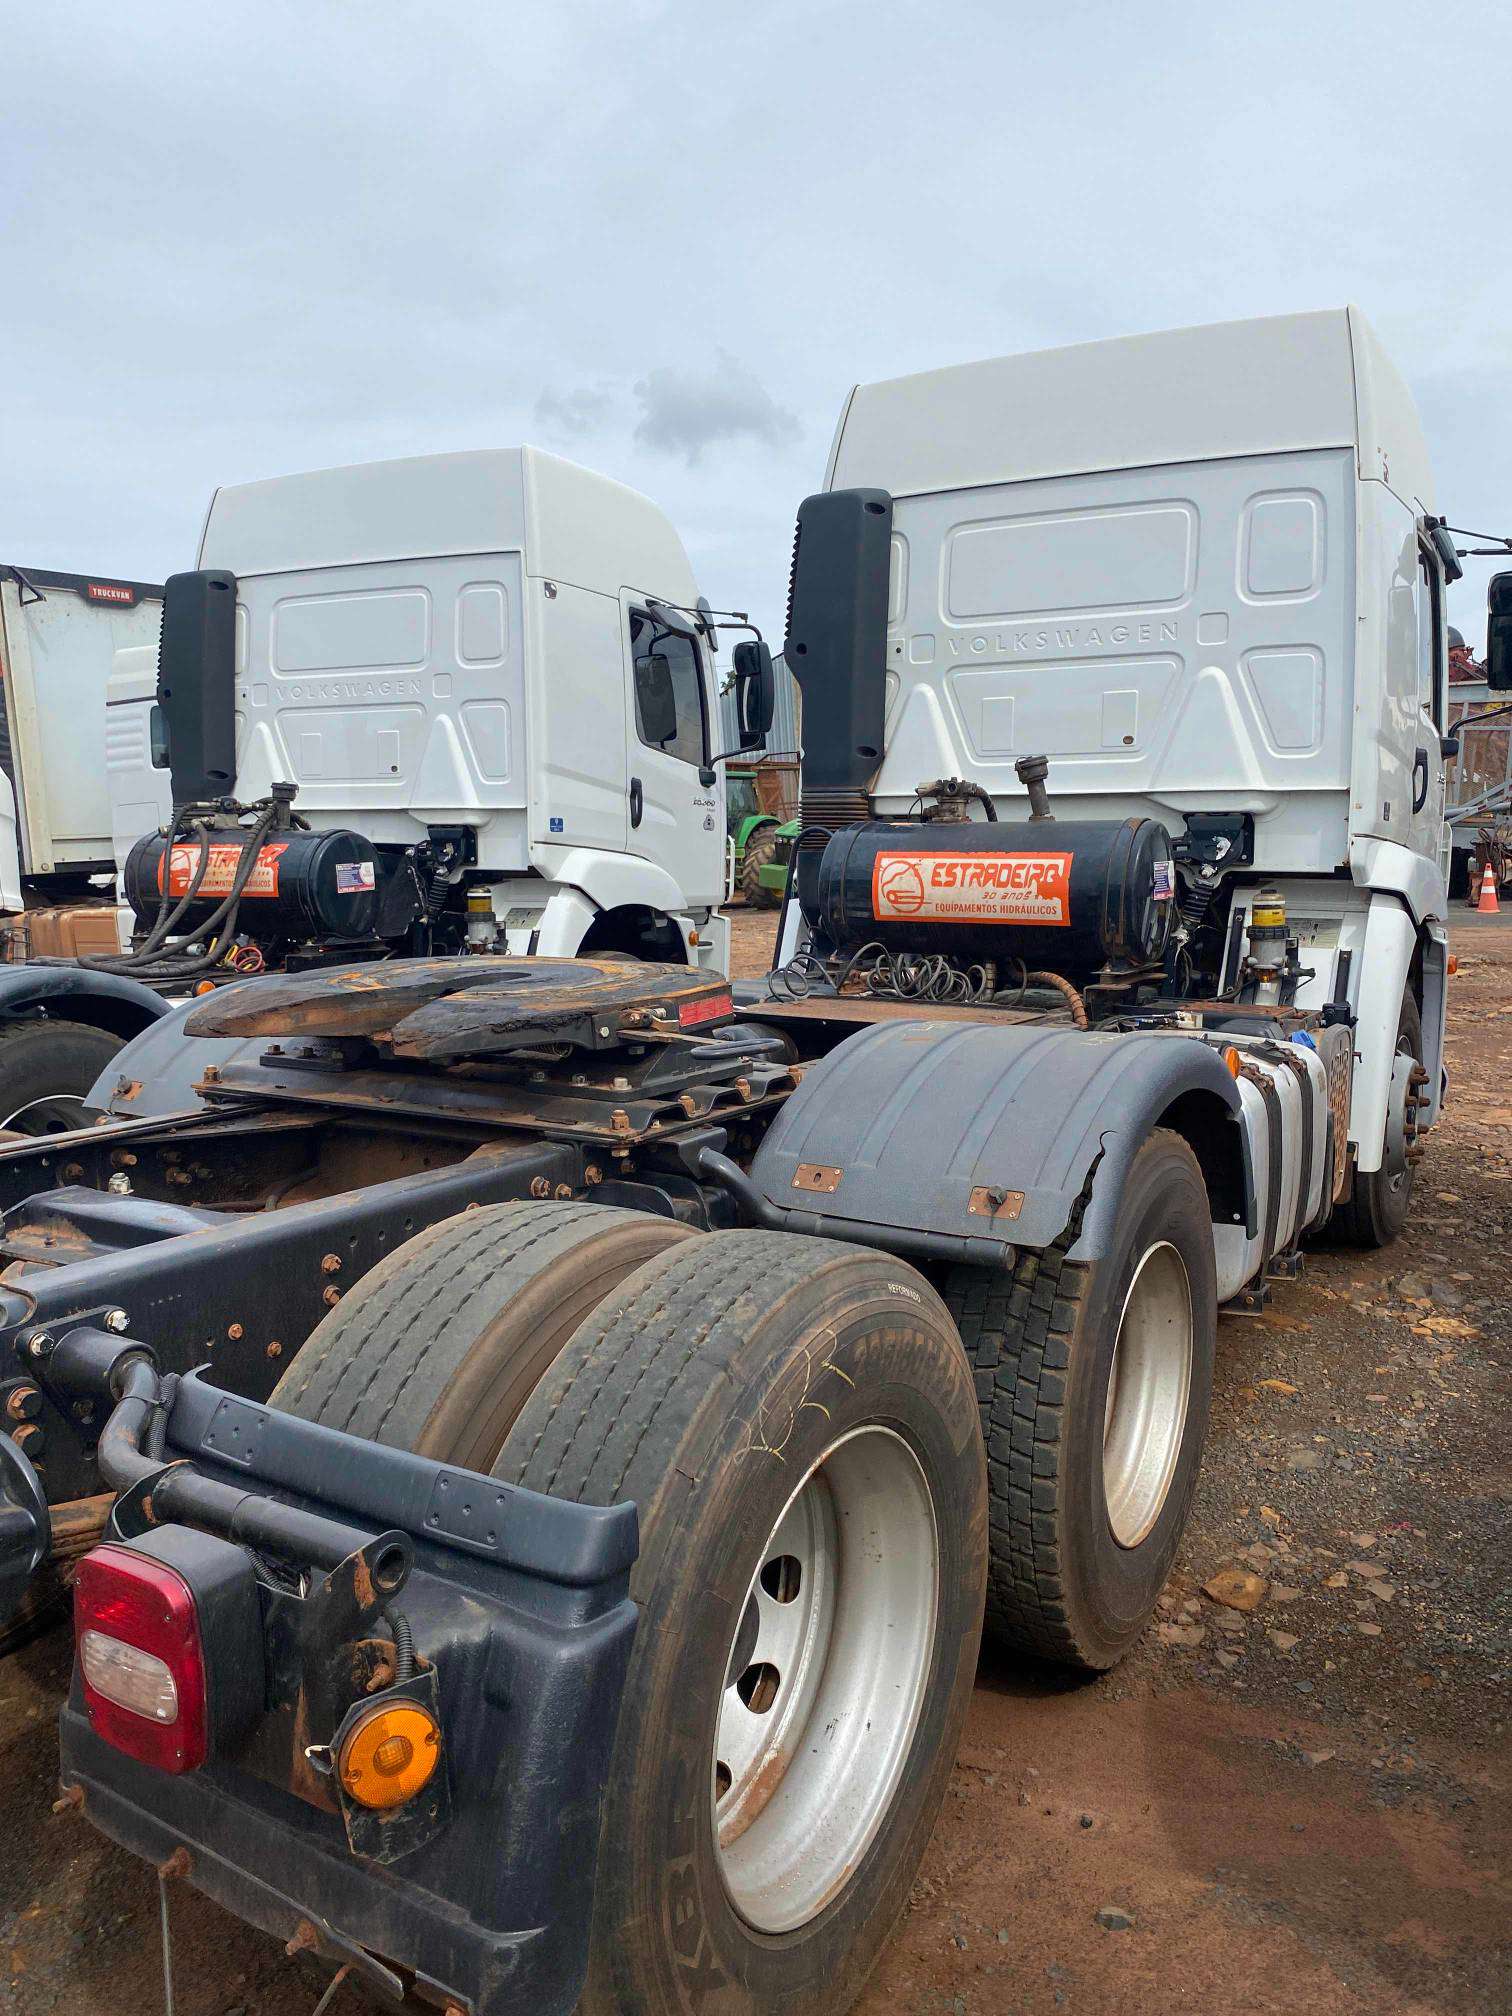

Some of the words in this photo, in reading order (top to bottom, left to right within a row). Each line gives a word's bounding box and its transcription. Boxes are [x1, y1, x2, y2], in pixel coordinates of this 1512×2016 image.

[92, 587, 130, 600] TRUCKVAN
[948, 622, 1178, 655] VOLKSWAGEN
[275, 679, 422, 701] VOLKSWAGEN
[935, 902, 997, 914] EQUIPAMENTOS
